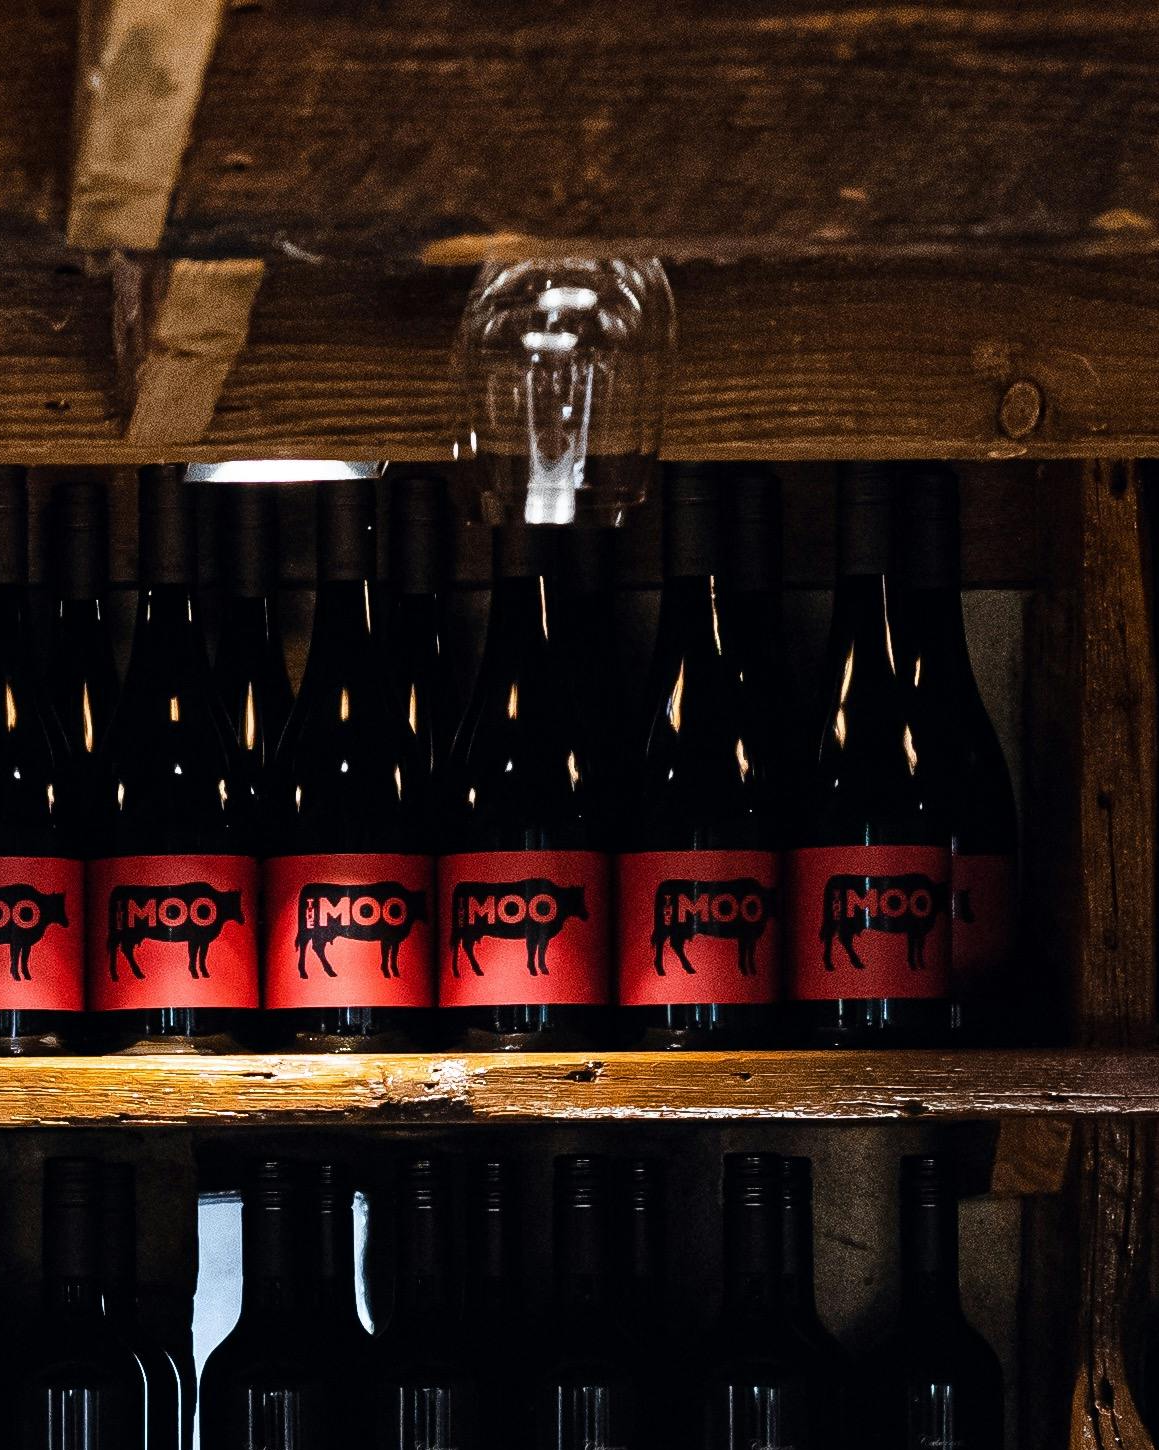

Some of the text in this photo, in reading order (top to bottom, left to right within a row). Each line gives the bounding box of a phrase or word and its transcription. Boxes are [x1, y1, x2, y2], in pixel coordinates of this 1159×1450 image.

[127, 897, 218, 928] MOO
[319, 896, 407, 926] MOO
[468, 894, 558, 925] MOO
[677, 892, 764, 923] MOO
[845, 888, 933, 919] MOO
